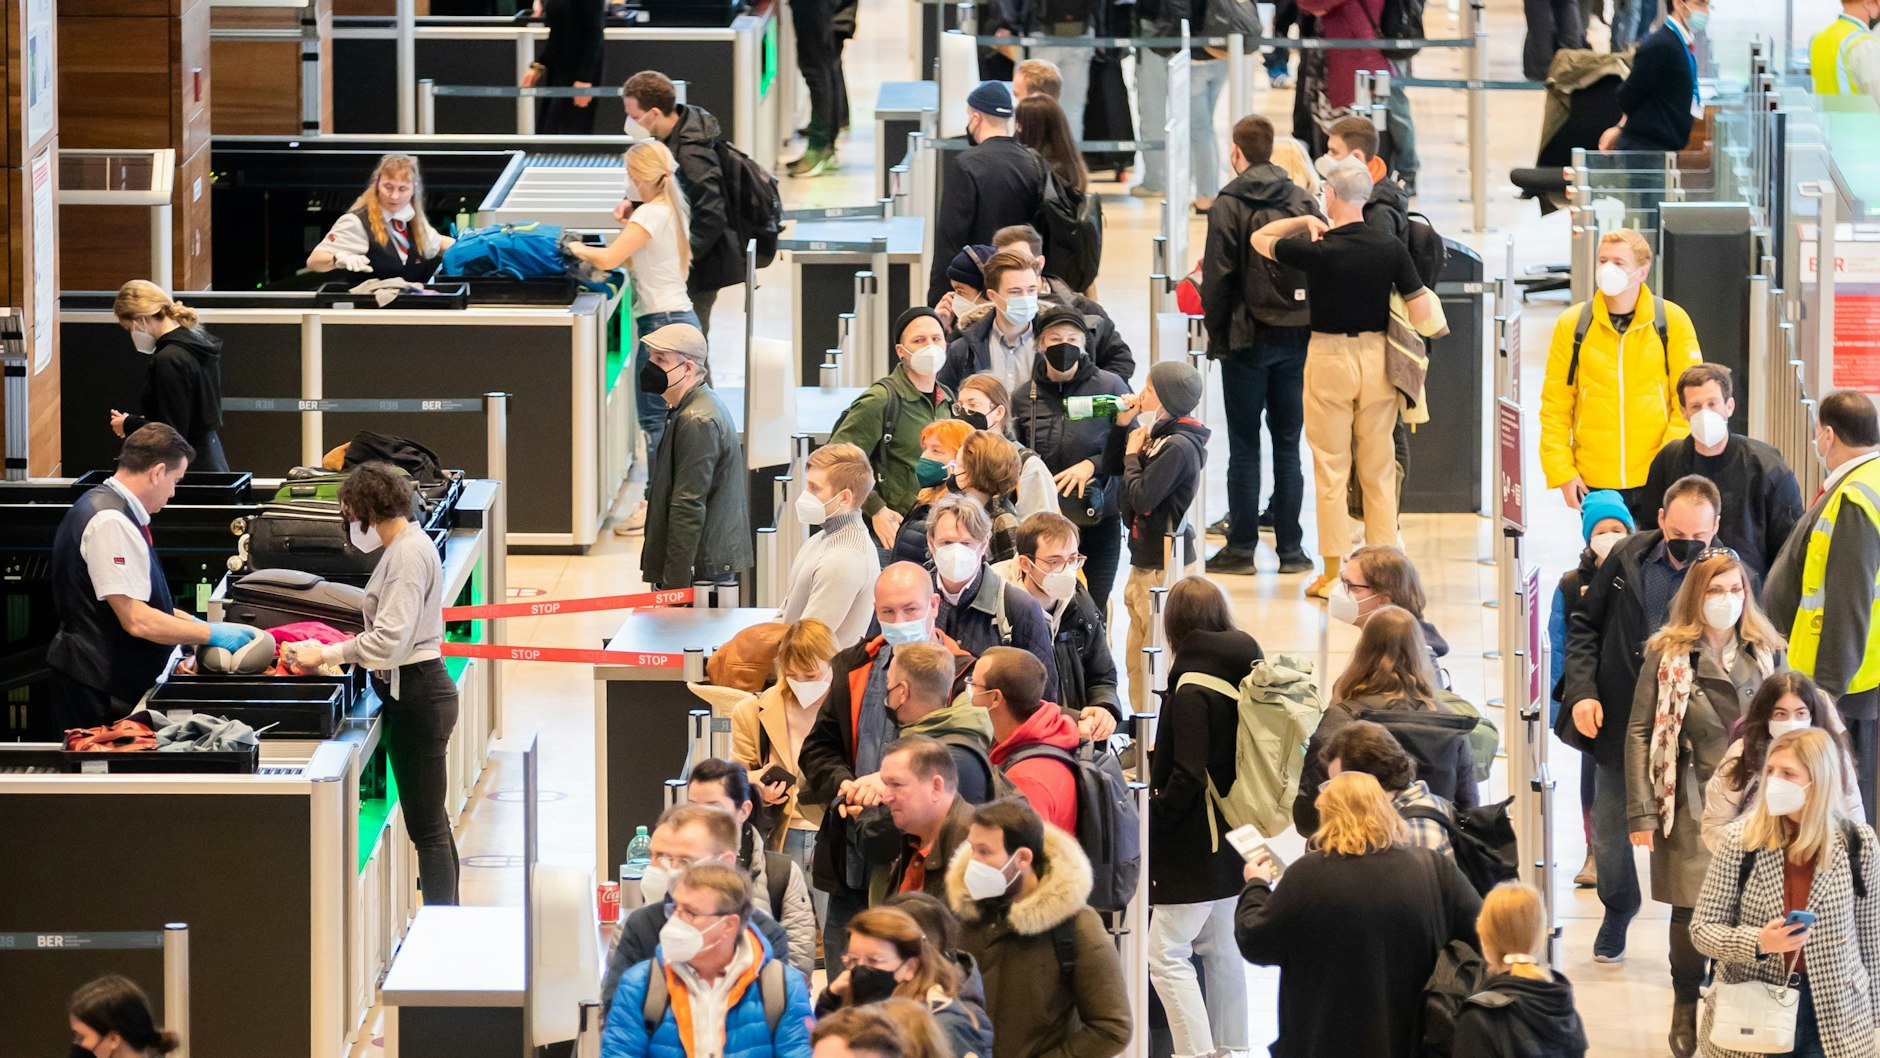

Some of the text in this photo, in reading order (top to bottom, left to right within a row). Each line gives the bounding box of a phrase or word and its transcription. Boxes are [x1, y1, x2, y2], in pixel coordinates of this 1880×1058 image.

[298, 400, 318, 410] BER
[421, 400, 442, 410] BER
[531, 591, 685, 615] STOP STOP
[511, 649, 668, 666] STOP STOP
[37, 935, 64, 947] BER
